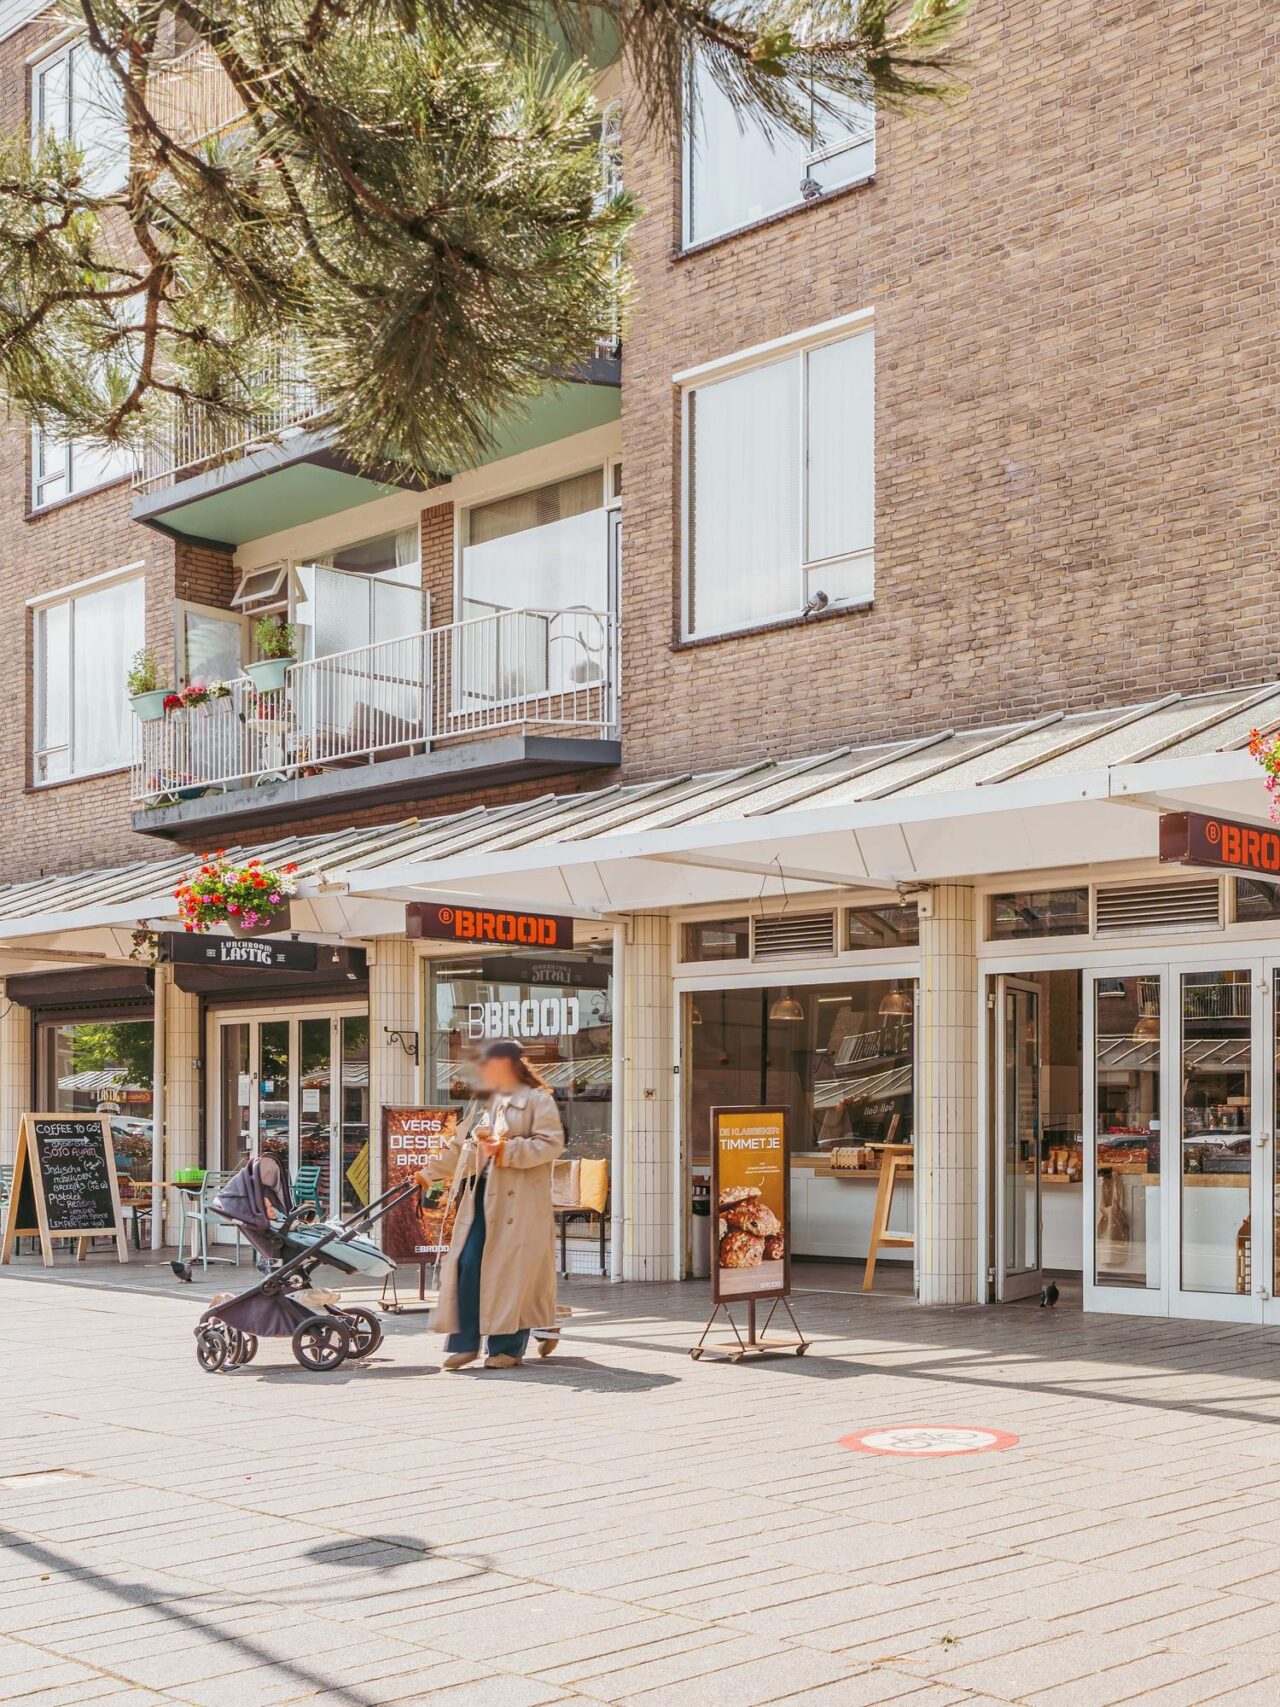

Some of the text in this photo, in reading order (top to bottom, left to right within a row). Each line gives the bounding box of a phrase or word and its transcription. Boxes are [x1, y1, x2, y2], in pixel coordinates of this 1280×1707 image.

[455, 909, 557, 945] BROOD
[220, 941, 272, 952] LUNCHROOM
[221, 947, 272, 965] LASTIG
[469, 997, 579, 1039] BBROOD
[36, 1123, 72, 1135] COFFEE
[74, 1124, 85, 1133] TO
[401, 1119, 442, 1131] VERS
[720, 1138, 780, 1150] TIMMETJE
